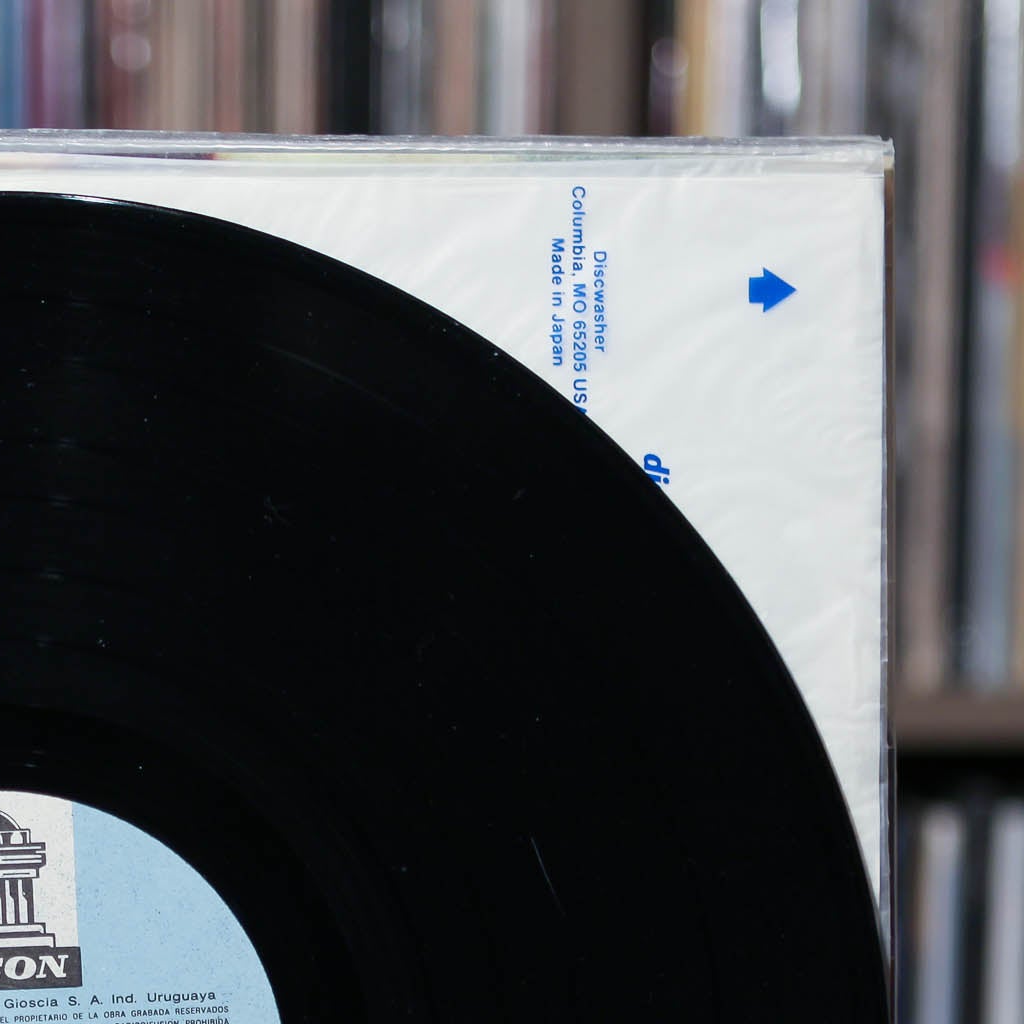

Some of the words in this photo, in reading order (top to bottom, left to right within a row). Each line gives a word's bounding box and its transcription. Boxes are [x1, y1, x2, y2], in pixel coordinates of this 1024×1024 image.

[572, 186, 586, 275] Columbia,
[552, 238, 566, 285] Made
[552, 291, 564, 307] in
[573, 283, 587, 314] MO
[593, 250, 608, 352] Discwasher
[550, 314, 565, 367] Japan
[573, 320, 587, 372] 65205
[13, 1013, 67, 1022] PROPIETARIO
[72, 1012, 83, 1020] DE
[88, 1011, 98, 1019] LA
[103, 1010, 126, 1018] OBRA
[130, 1008, 170, 1017] GRABADA
[174, 1005, 229, 1015] RESERVADOS
[68, 995, 80, 1006] S.
[90, 994, 103, 1005] A.
[111, 993, 136, 1004] Ind.
[146, 991, 216, 1004] Uruguaya
